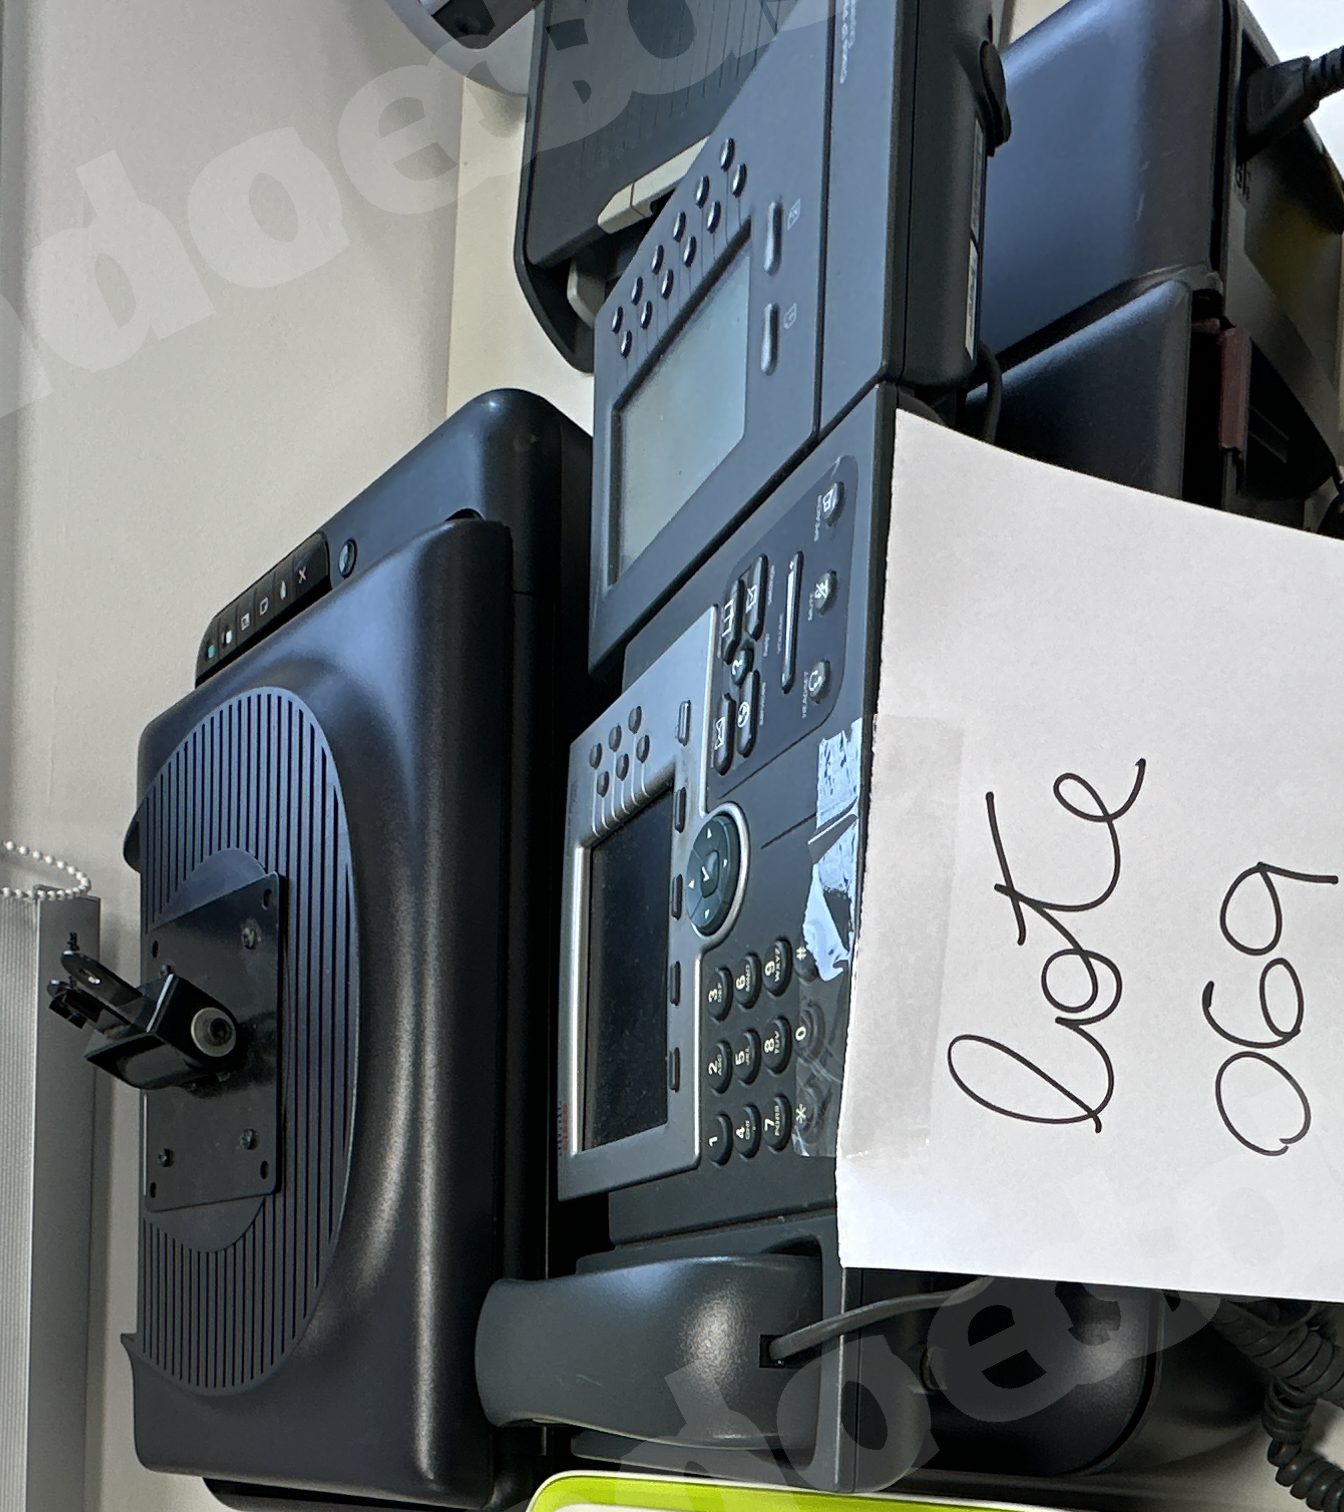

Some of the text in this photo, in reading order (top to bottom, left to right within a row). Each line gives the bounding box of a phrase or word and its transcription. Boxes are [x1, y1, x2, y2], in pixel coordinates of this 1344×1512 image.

[765, 960, 776, 976] 9
[736, 975, 746, 990] 6
[708, 989, 718, 1003] 3
[1201, 862, 1338, 1156] 069
[795, 1026, 806, 1041] 0
[764, 1038, 774, 1053] 8
[735, 1050, 746, 1065] 5
[708, 1060, 718, 1074] 2
[736, 1126, 746, 1139] 4
[764, 1118, 774, 1132] 7
[708, 1136, 718, 1146] 1
